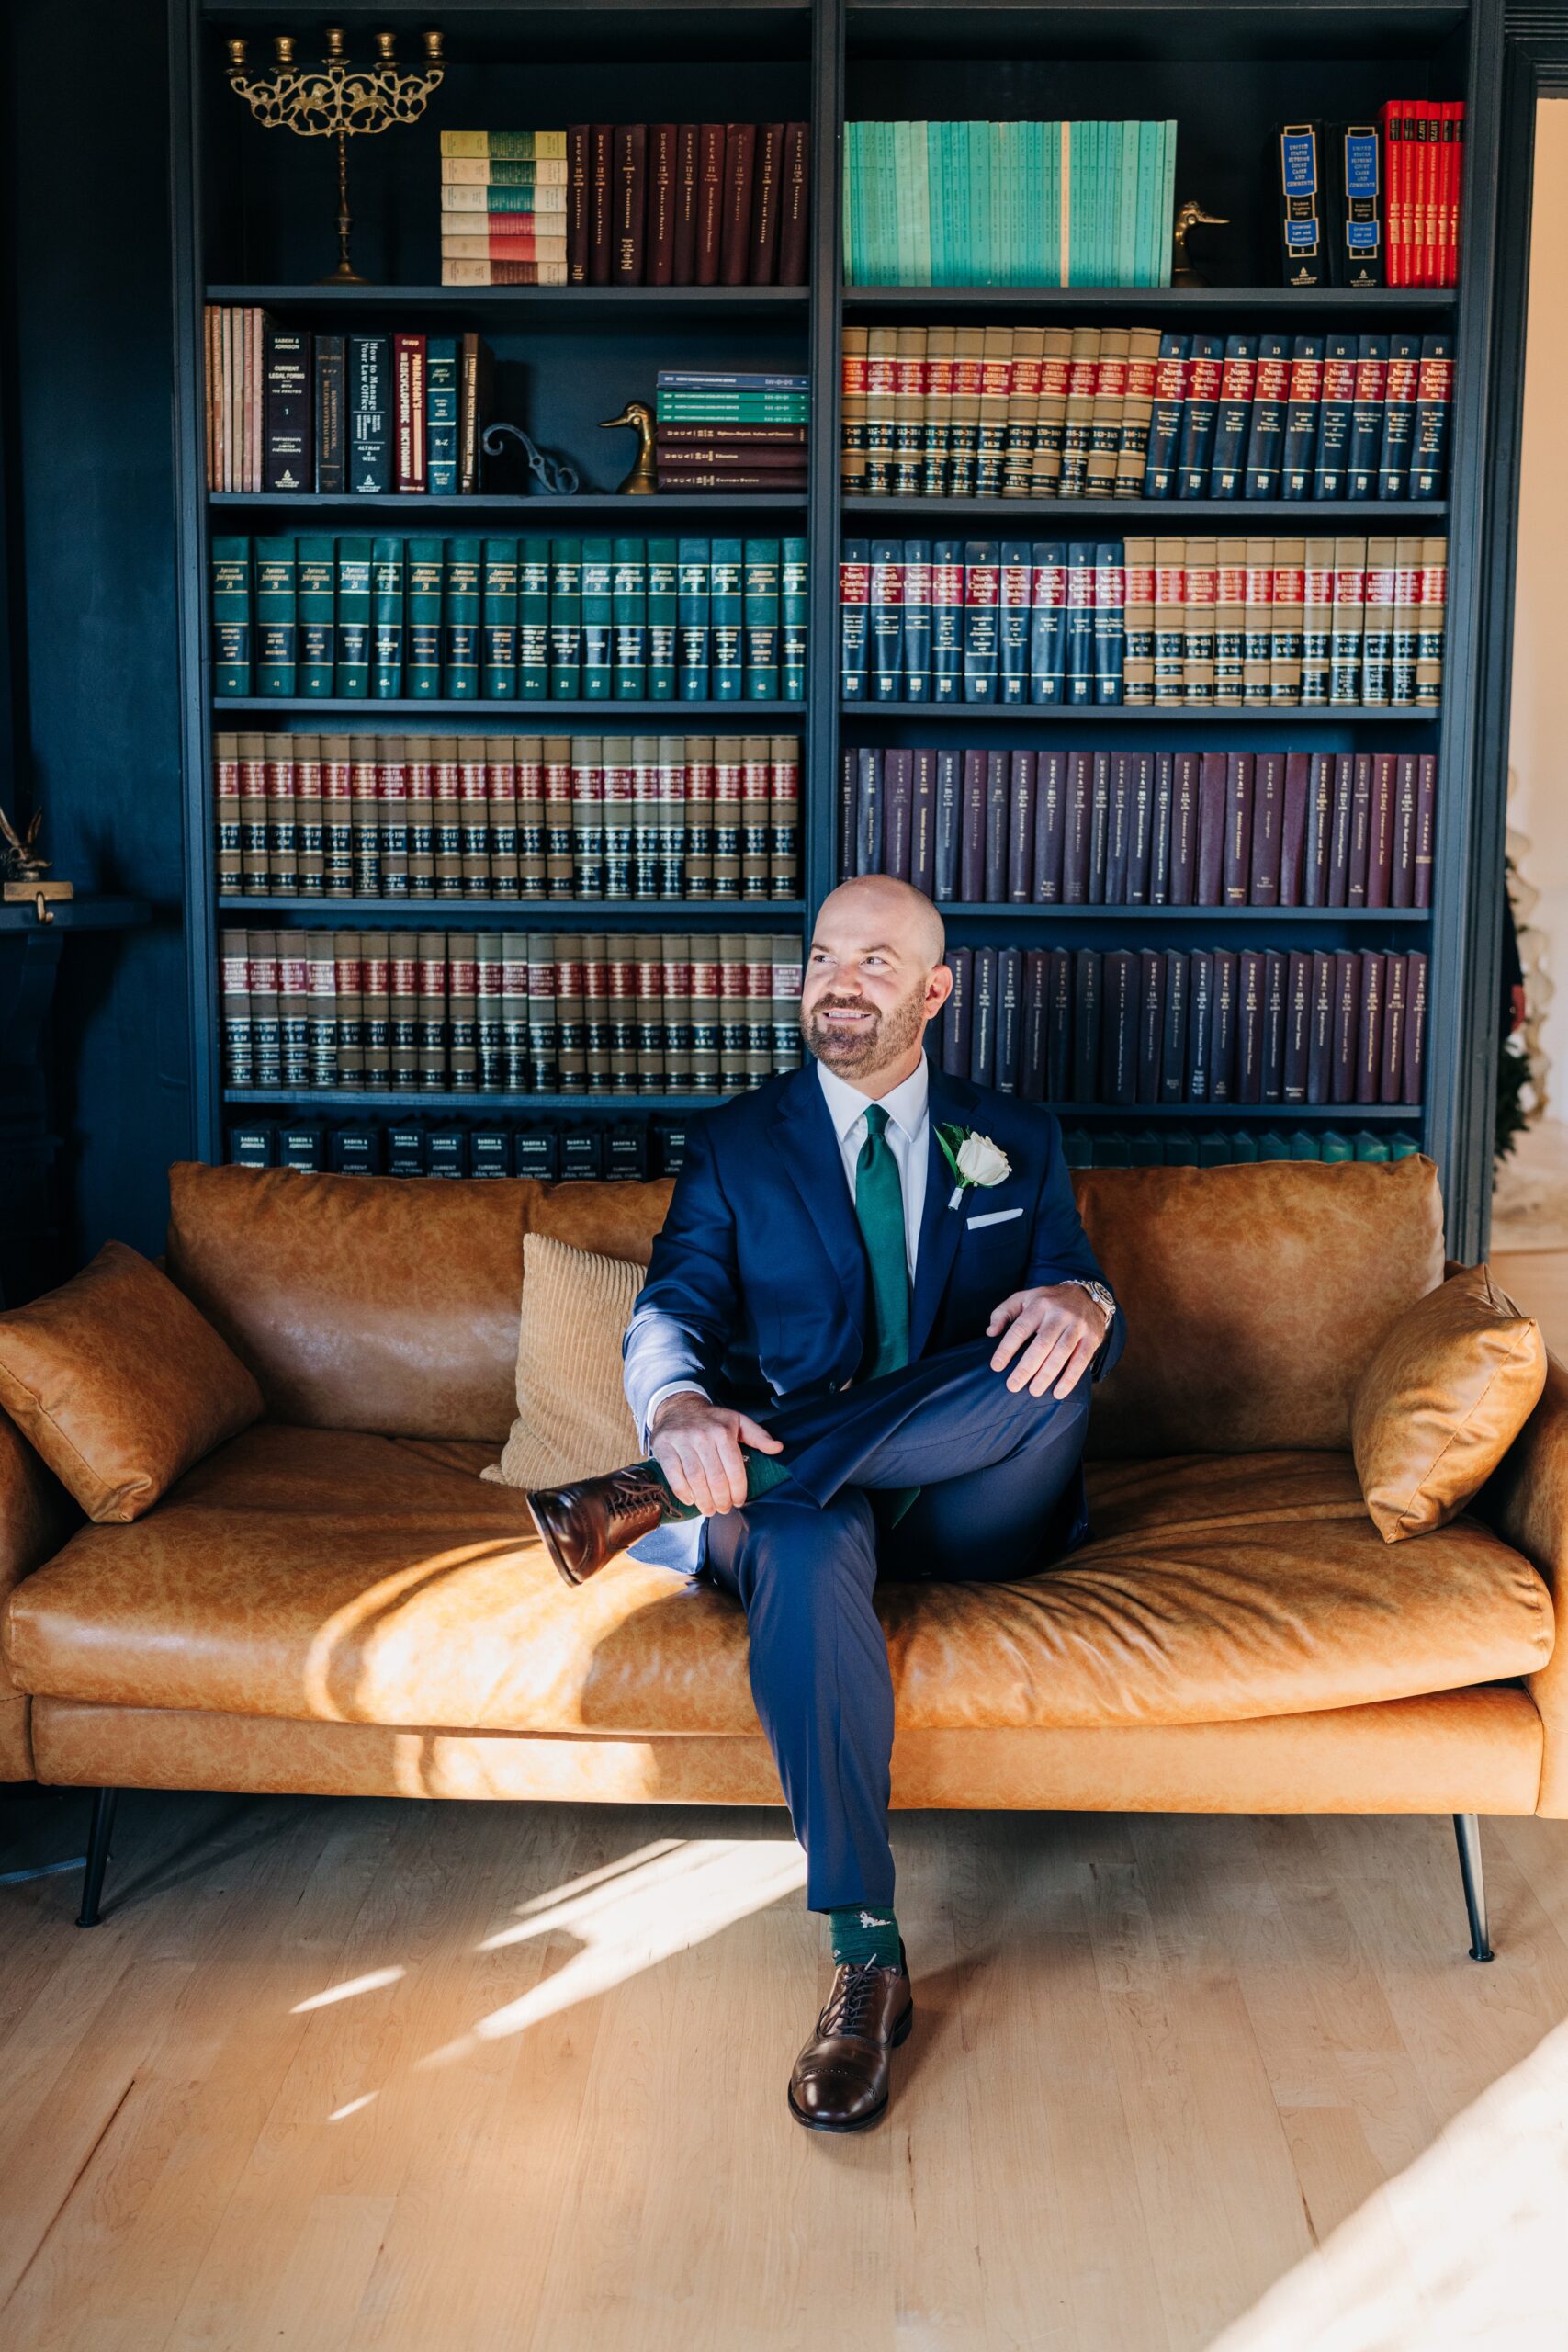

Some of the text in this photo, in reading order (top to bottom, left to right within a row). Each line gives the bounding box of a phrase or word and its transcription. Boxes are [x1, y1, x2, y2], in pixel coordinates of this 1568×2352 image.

[370, 365, 378, 374] to
[412, 354, 423, 409] PARALEGAL'S
[1157, 376, 1186, 384] Carolina
[1190, 376, 1219, 384] Carolina
[1224, 376, 1253, 384] Carolina
[1258, 376, 1287, 384] Carolina
[361, 386, 369, 410] Office
[368, 377, 378, 410] Manage
[400, 362, 411, 478] ENCYCLOPEDIC DICTIONARY
